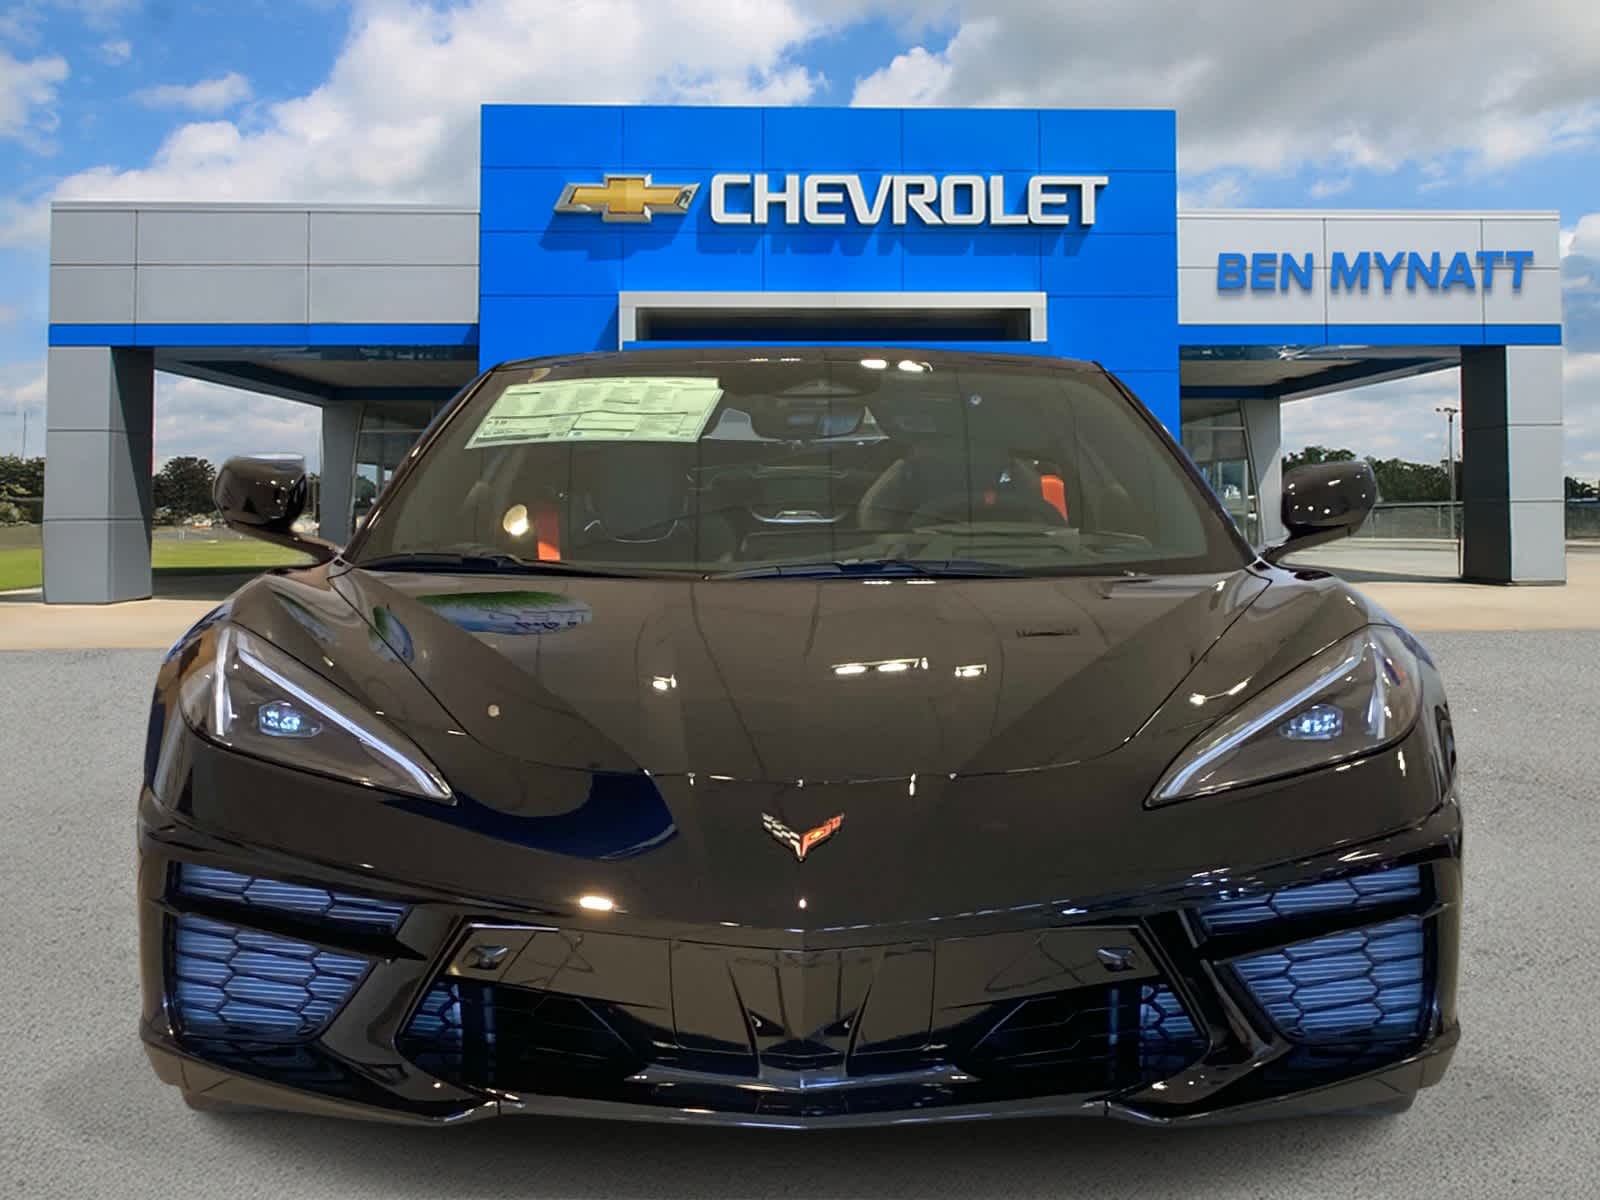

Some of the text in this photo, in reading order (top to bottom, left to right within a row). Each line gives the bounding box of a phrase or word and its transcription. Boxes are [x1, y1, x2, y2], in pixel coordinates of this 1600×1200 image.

[710, 173, 1109, 226] CHEVROLET
[1217, 250, 1535, 291] BEN MYNATT
